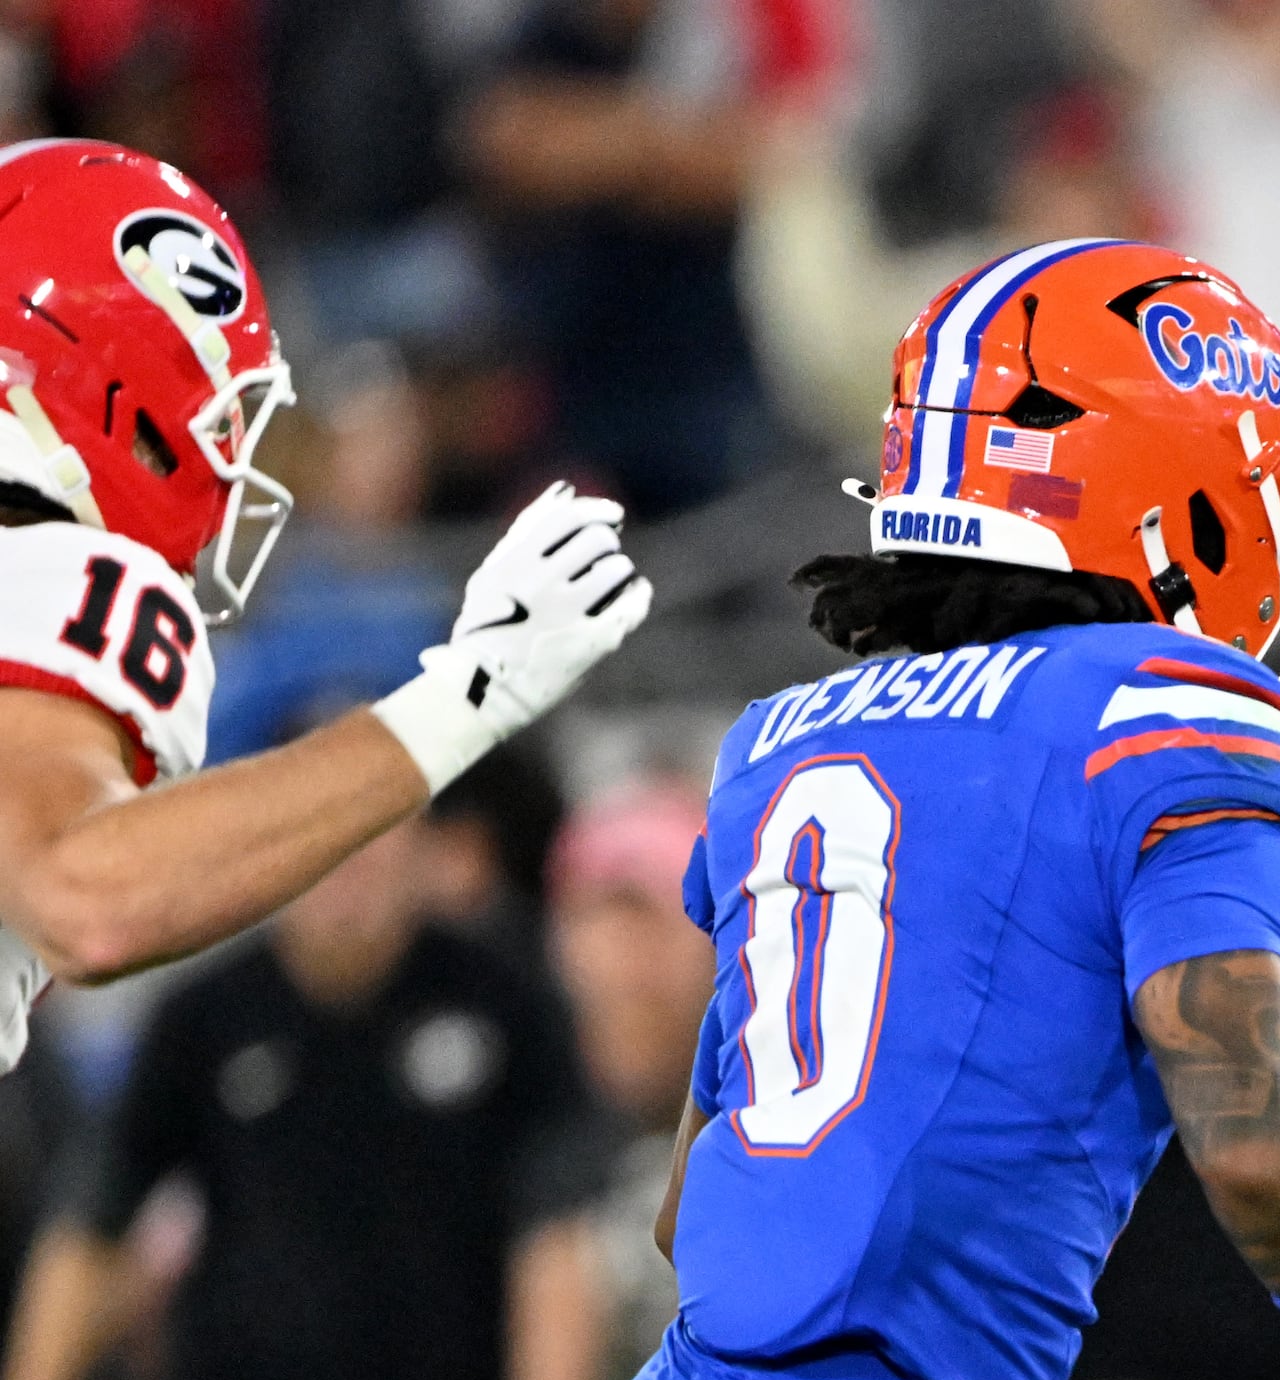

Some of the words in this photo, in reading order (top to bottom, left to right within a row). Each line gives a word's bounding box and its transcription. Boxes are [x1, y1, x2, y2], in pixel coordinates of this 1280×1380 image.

[881, 510, 981, 547] FLORIDA
[59, 555, 196, 712] 16
[748, 645, 1048, 764] DENSON
[731, 753, 901, 1158] 0
